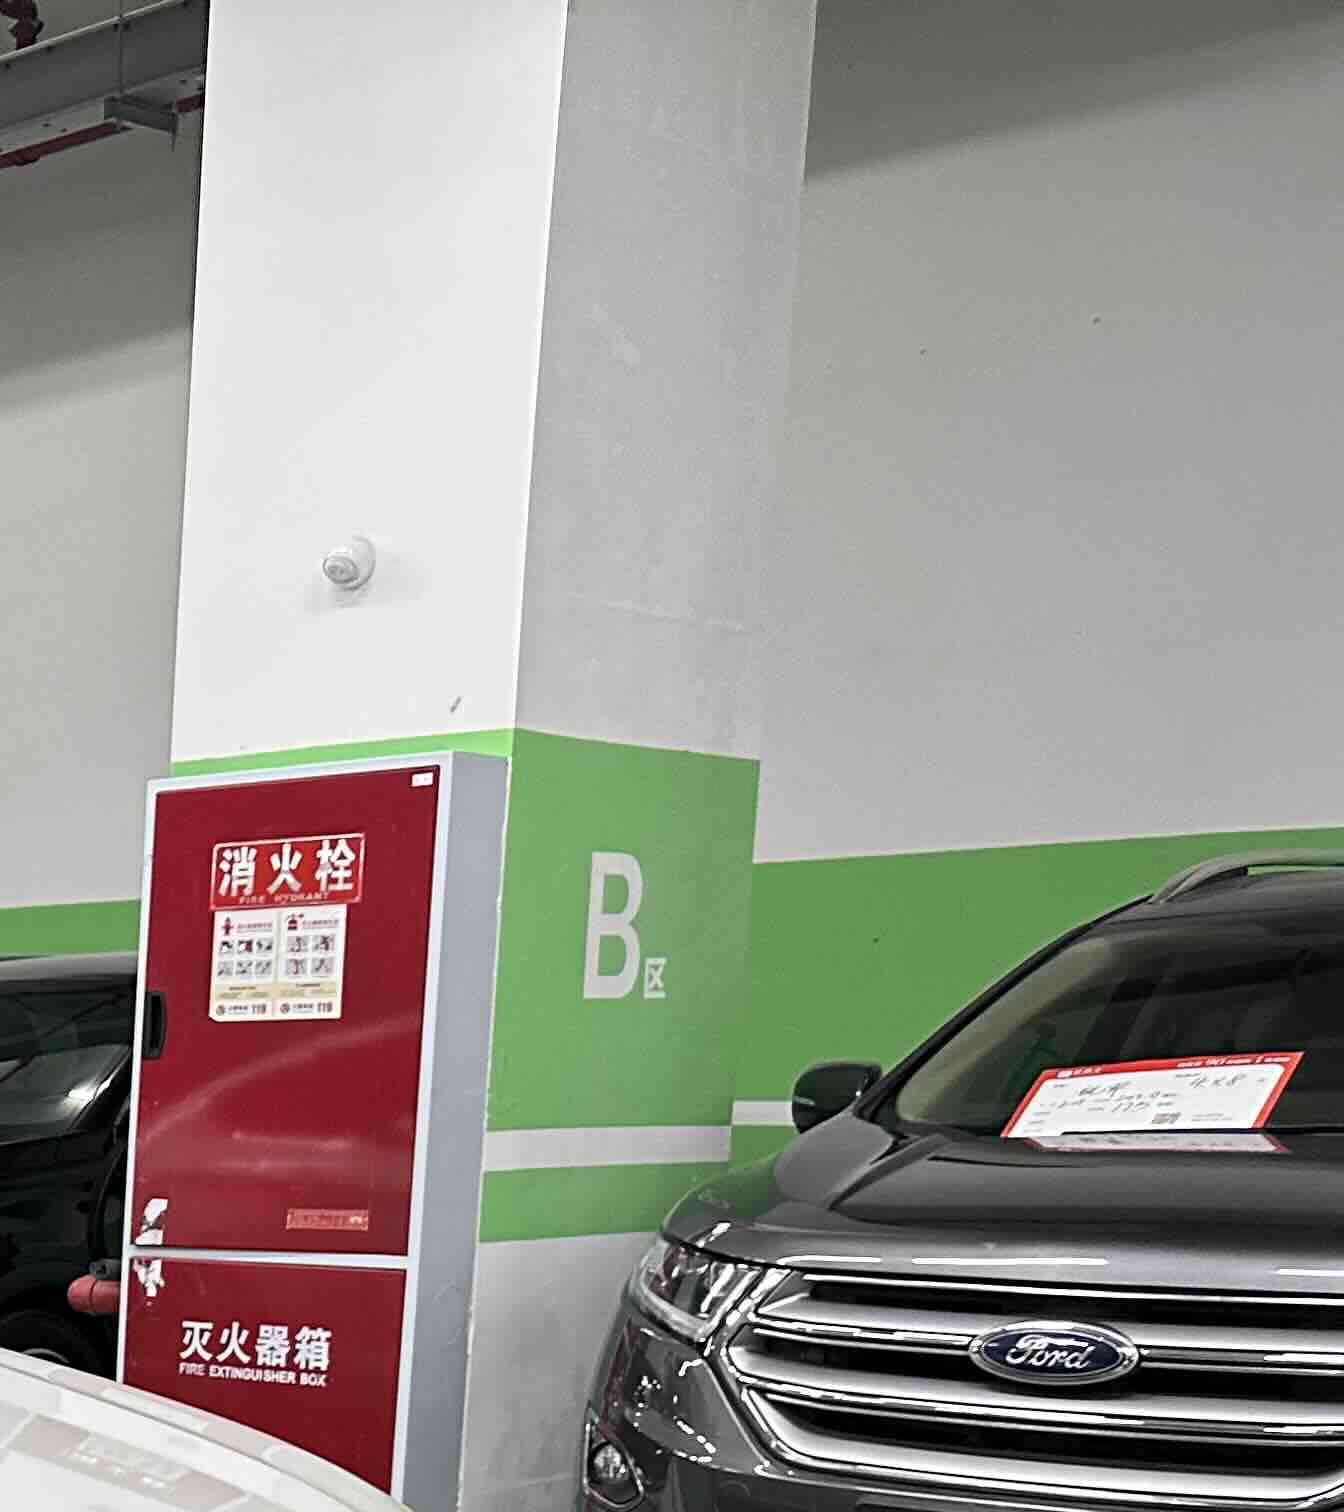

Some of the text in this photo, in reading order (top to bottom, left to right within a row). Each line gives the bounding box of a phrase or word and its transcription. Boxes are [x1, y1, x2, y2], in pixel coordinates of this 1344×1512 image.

[219, 839, 356, 897] 消火栓
[179, 1321, 332, 1371] 灭火器箱
[1005, 1333, 1092, 1370] Ford
[178, 1362, 328, 1388] FIRE EXTINGUISHER BOX
